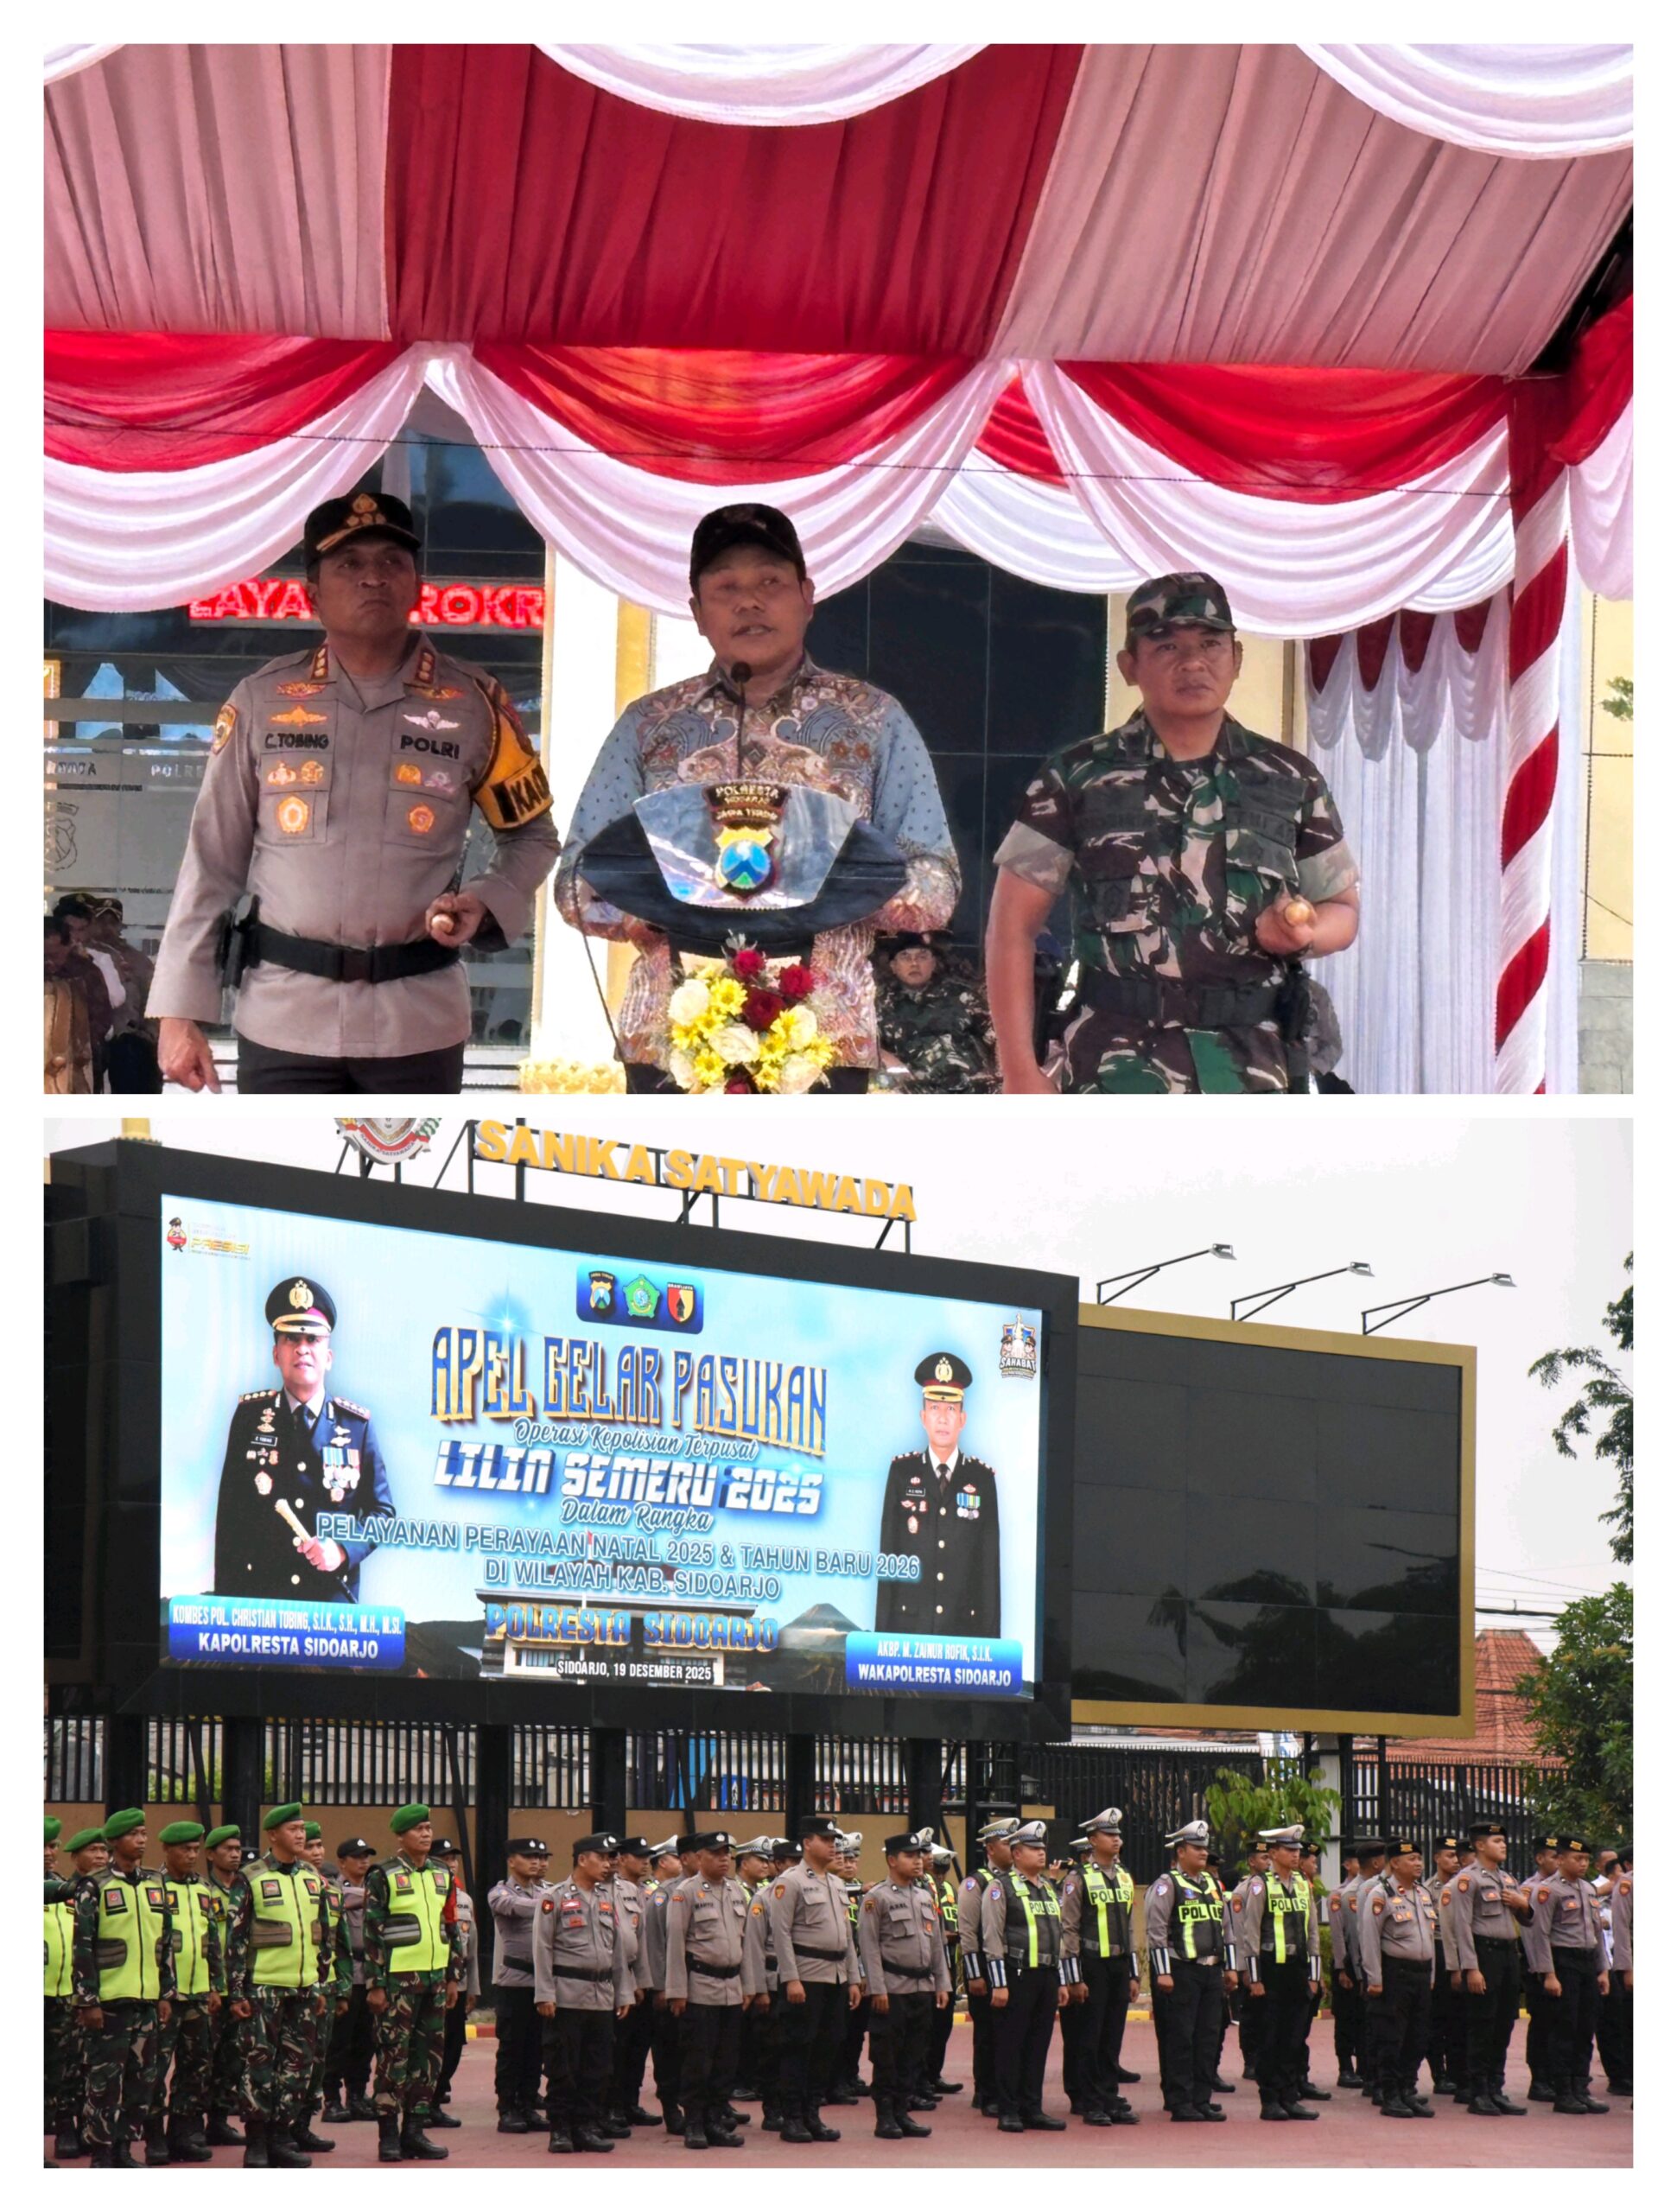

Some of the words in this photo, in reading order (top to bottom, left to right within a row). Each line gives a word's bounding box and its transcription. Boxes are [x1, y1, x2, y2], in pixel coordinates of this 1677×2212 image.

[400, 735, 460, 759] POLRI
[474, 1120, 657, 1185] SANIKA
[663, 1149, 918, 1222] SATYAWADA
[1000, 1357, 1037, 1372] SAHABAT
[429, 1326, 534, 1421] APEL
[543, 1335, 660, 1424] GELAR
[671, 1349, 828, 1456] PASUKAN
[515, 1416, 587, 1449] Operasi
[590, 1424, 683, 1457] Kepolisian
[683, 1433, 759, 1464] Terpusat
[433, 1440, 553, 1497] LILIN
[560, 1452, 718, 1508] SEMERU
[722, 1466, 824, 1515] 2025
[560, 1497, 631, 1526] Dalam
[632, 1501, 714, 1535] Rangka
[316, 1513, 459, 1548] PELAYANAN
[464, 1522, 587, 1557] PERAYAAN
[593, 1532, 661, 1562] NATAL
[667, 1540, 712, 1565] 2025
[719, 1542, 734, 1567] &
[740, 1544, 810, 1572] TAHUN
[815, 1548, 872, 1576] BARU
[875, 1554, 920, 1579] 2026
[486, 1556, 507, 1584] DI
[512, 1560, 612, 1590] WILAYAH
[616, 1565, 669, 1592] KAB.
[674, 1570, 780, 1599] SIDOARJO
[173, 1605, 209, 1625] KOMBES
[211, 1607, 230, 1626] POL.
[232, 1608, 276, 1629] CHRISTIAN
[278, 1610, 311, 1632] TOBING,
[339, 1613, 358, 1635] S.H.,
[359, 1614, 380, 1636] M.H.,
[485, 1602, 632, 1645] POLRESTA
[643, 1611, 779, 1652] SIDOARJO
[199, 1632, 300, 1656] KAPOLRESTA
[304, 1637, 378, 1659] SIDOARJO
[877, 1640, 900, 1657] AKBP.
[902, 1643, 912, 1658] M.
[914, 1642, 943, 1660] ZAINUR
[944, 1643, 970, 1662] ROFIK,
[972, 1645, 993, 1662] S.I.K.
[557, 1660, 610, 1677] SIDOARJO,
[613, 1662, 626, 1677] 19
[629, 1662, 683, 1679] DESEMBER
[685, 1665, 712, 1681] 2025
[858, 1663, 951, 1684] WAKAPOLRESTA
[954, 1667, 1012, 1687] SIDOARJO
